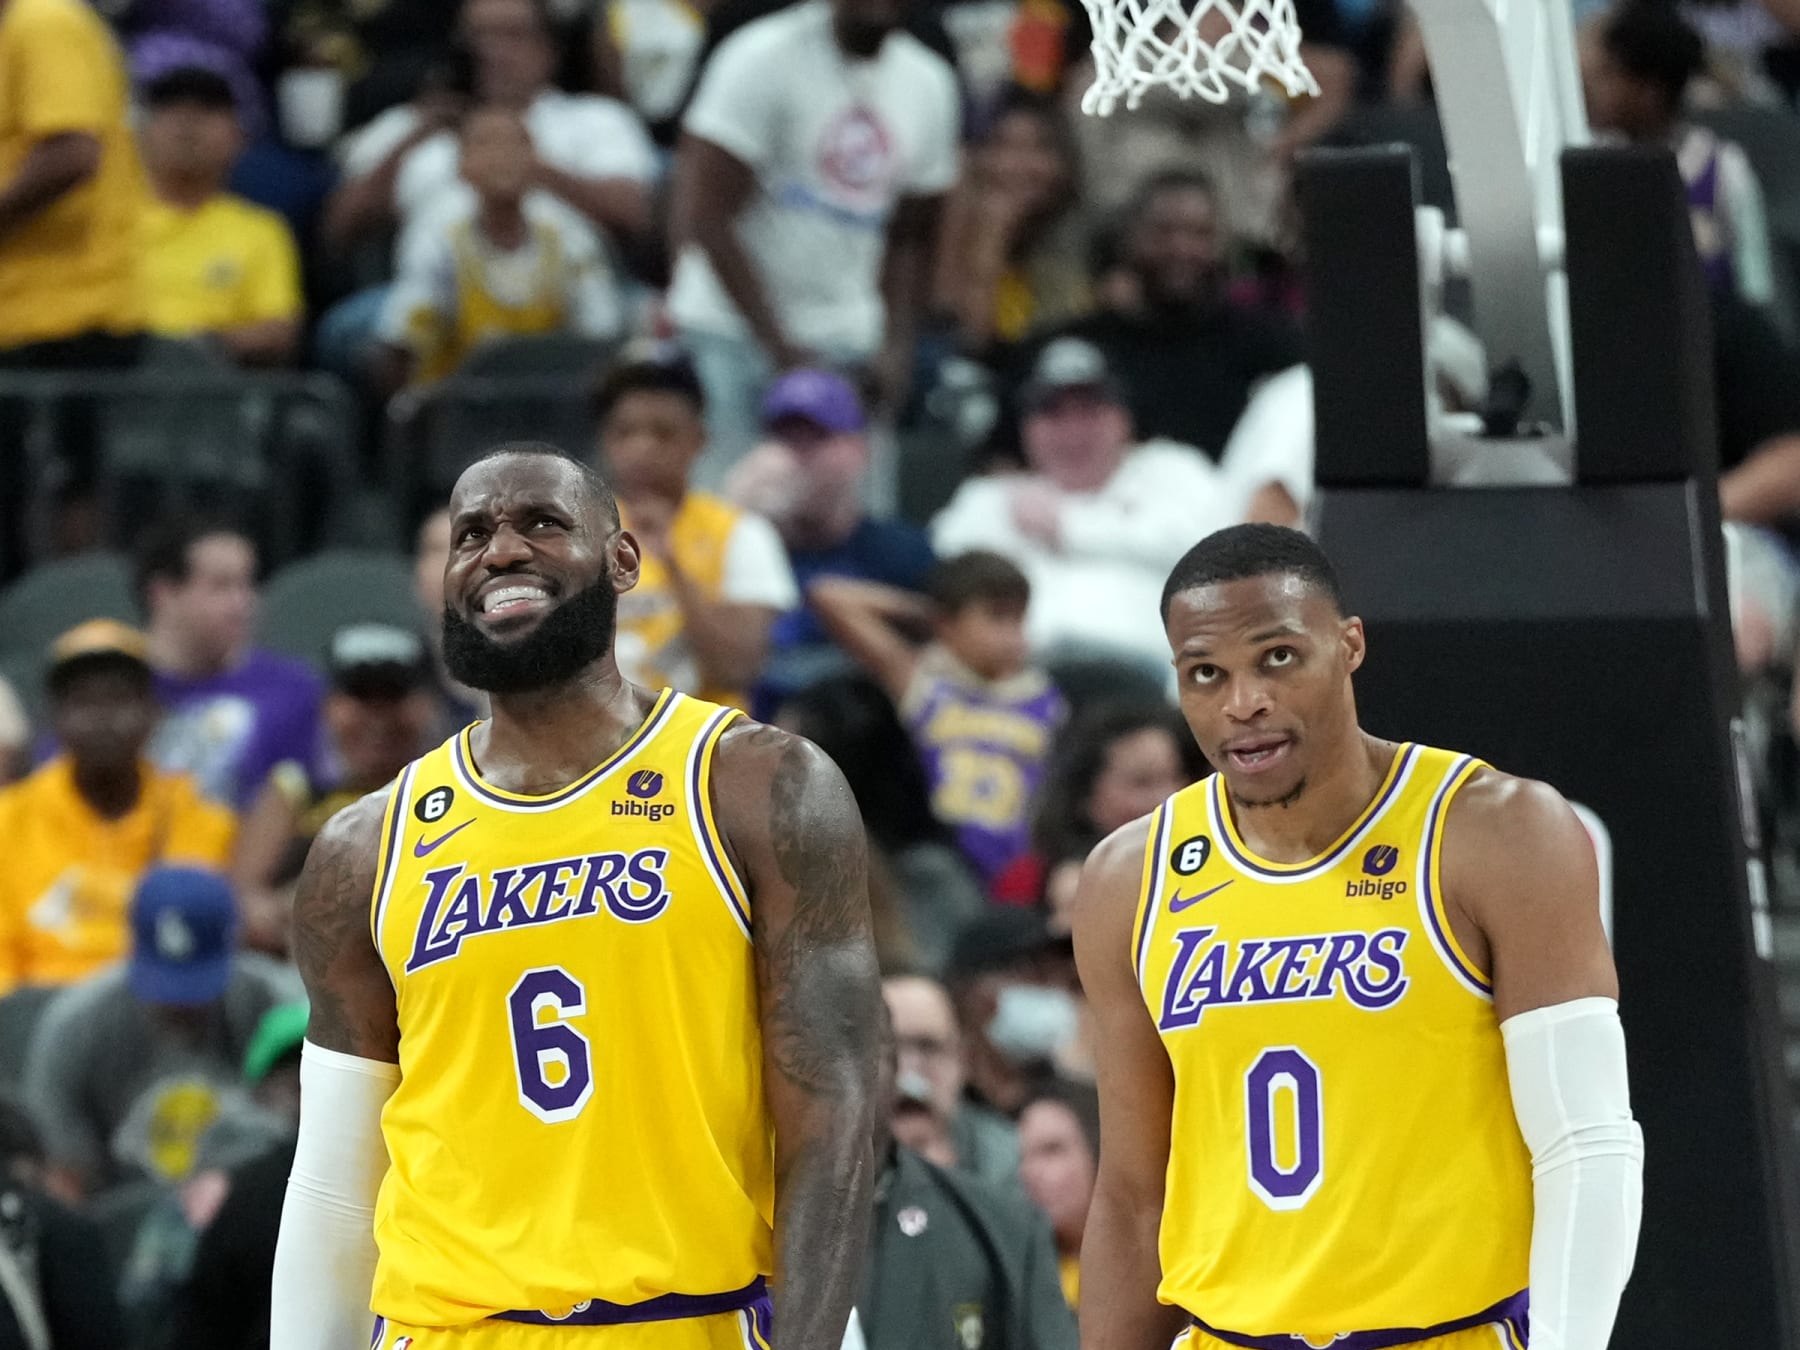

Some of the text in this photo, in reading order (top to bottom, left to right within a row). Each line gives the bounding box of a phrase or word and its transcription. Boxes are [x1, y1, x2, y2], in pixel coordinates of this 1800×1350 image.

[424, 790, 446, 819] 6
[611, 800, 675, 822] bibigo
[1179, 840, 1204, 872] 6
[1345, 878, 1408, 900] bibigo
[403, 847, 673, 977] LAKERS
[1157, 924, 1412, 1036] LAKERS
[505, 964, 595, 1125] 6
[1243, 1044, 1325, 1212] 0
